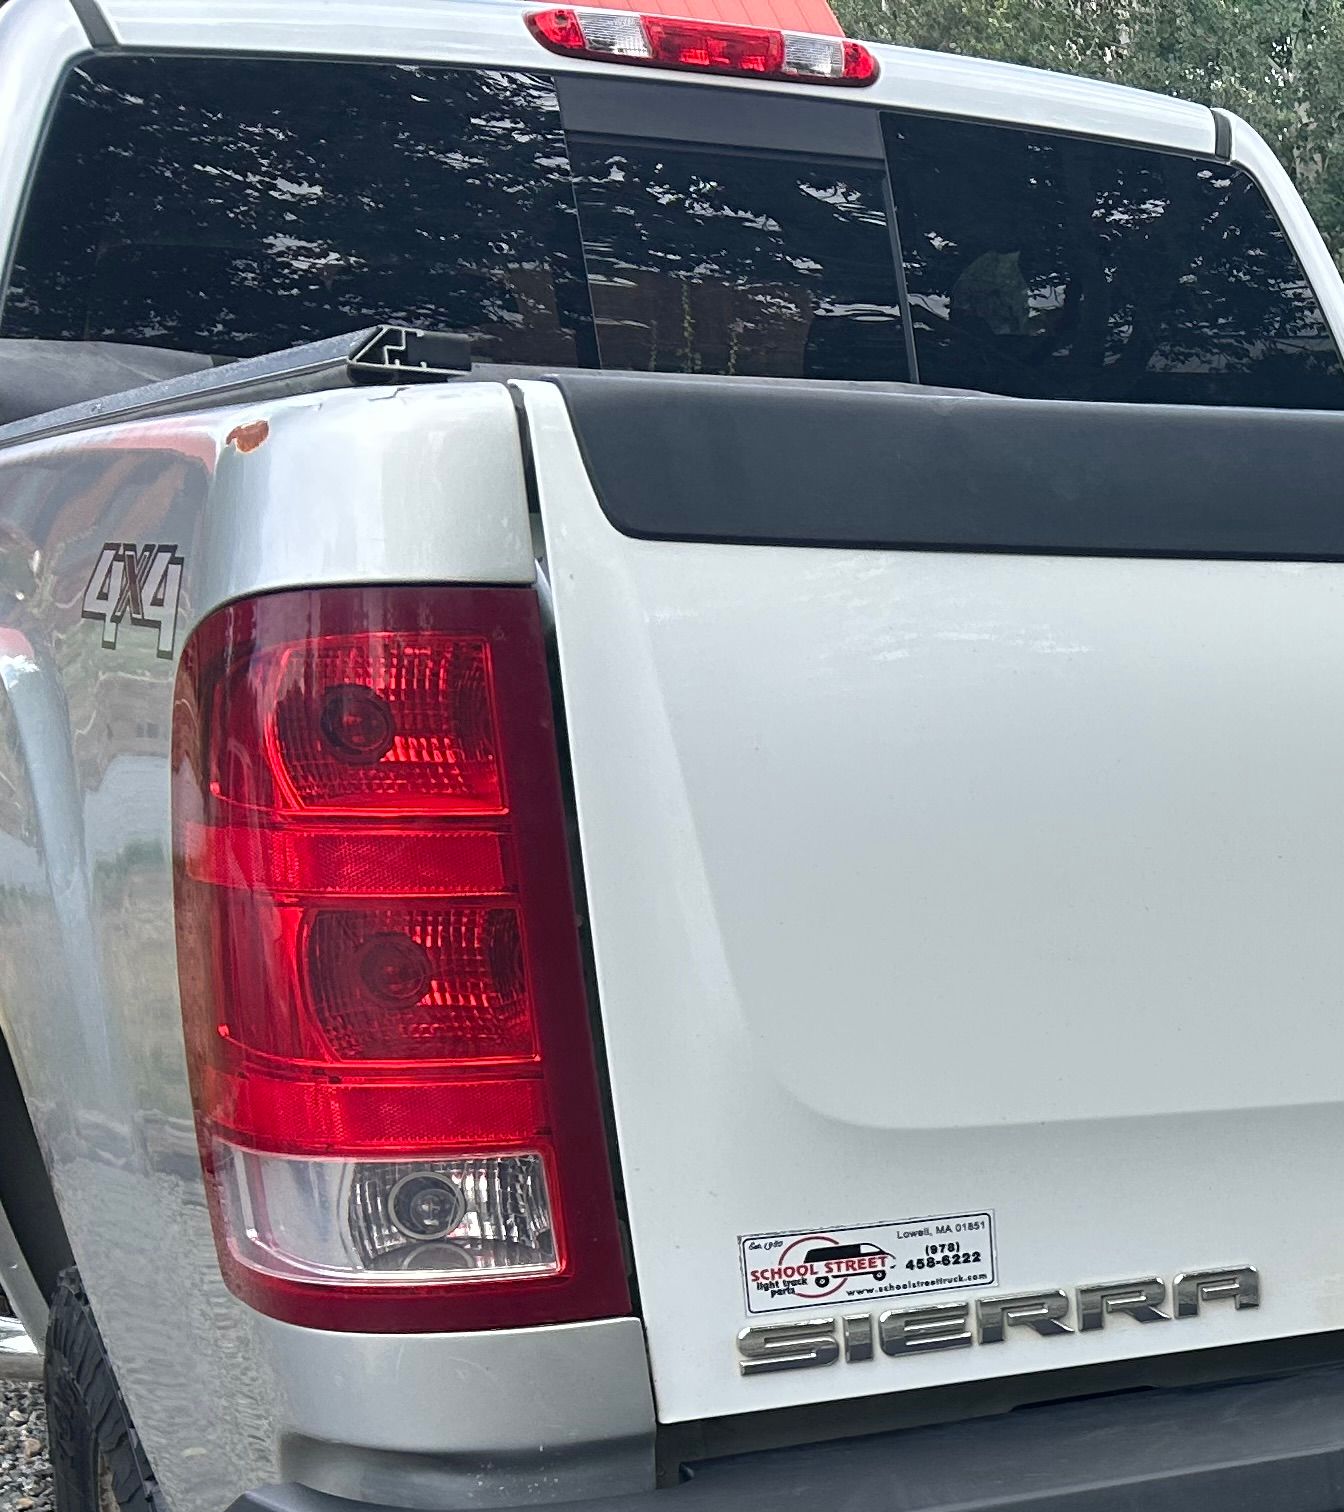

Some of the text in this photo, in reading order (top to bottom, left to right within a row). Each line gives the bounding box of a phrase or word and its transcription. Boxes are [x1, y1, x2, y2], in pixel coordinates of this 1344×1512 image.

[897, 1221, 985, 1240] Lowell, MA 01851
[926, 1241, 960, 1256] (978)
[750, 1256, 887, 1282] SCHOOL STREET
[906, 1251, 981, 1271] 458-6222
[757, 1277, 808, 1292] light truck
[846, 1273, 987, 1297] www.schoolstreettruck.com
[736, 1263, 1261, 1376] SIERRA
